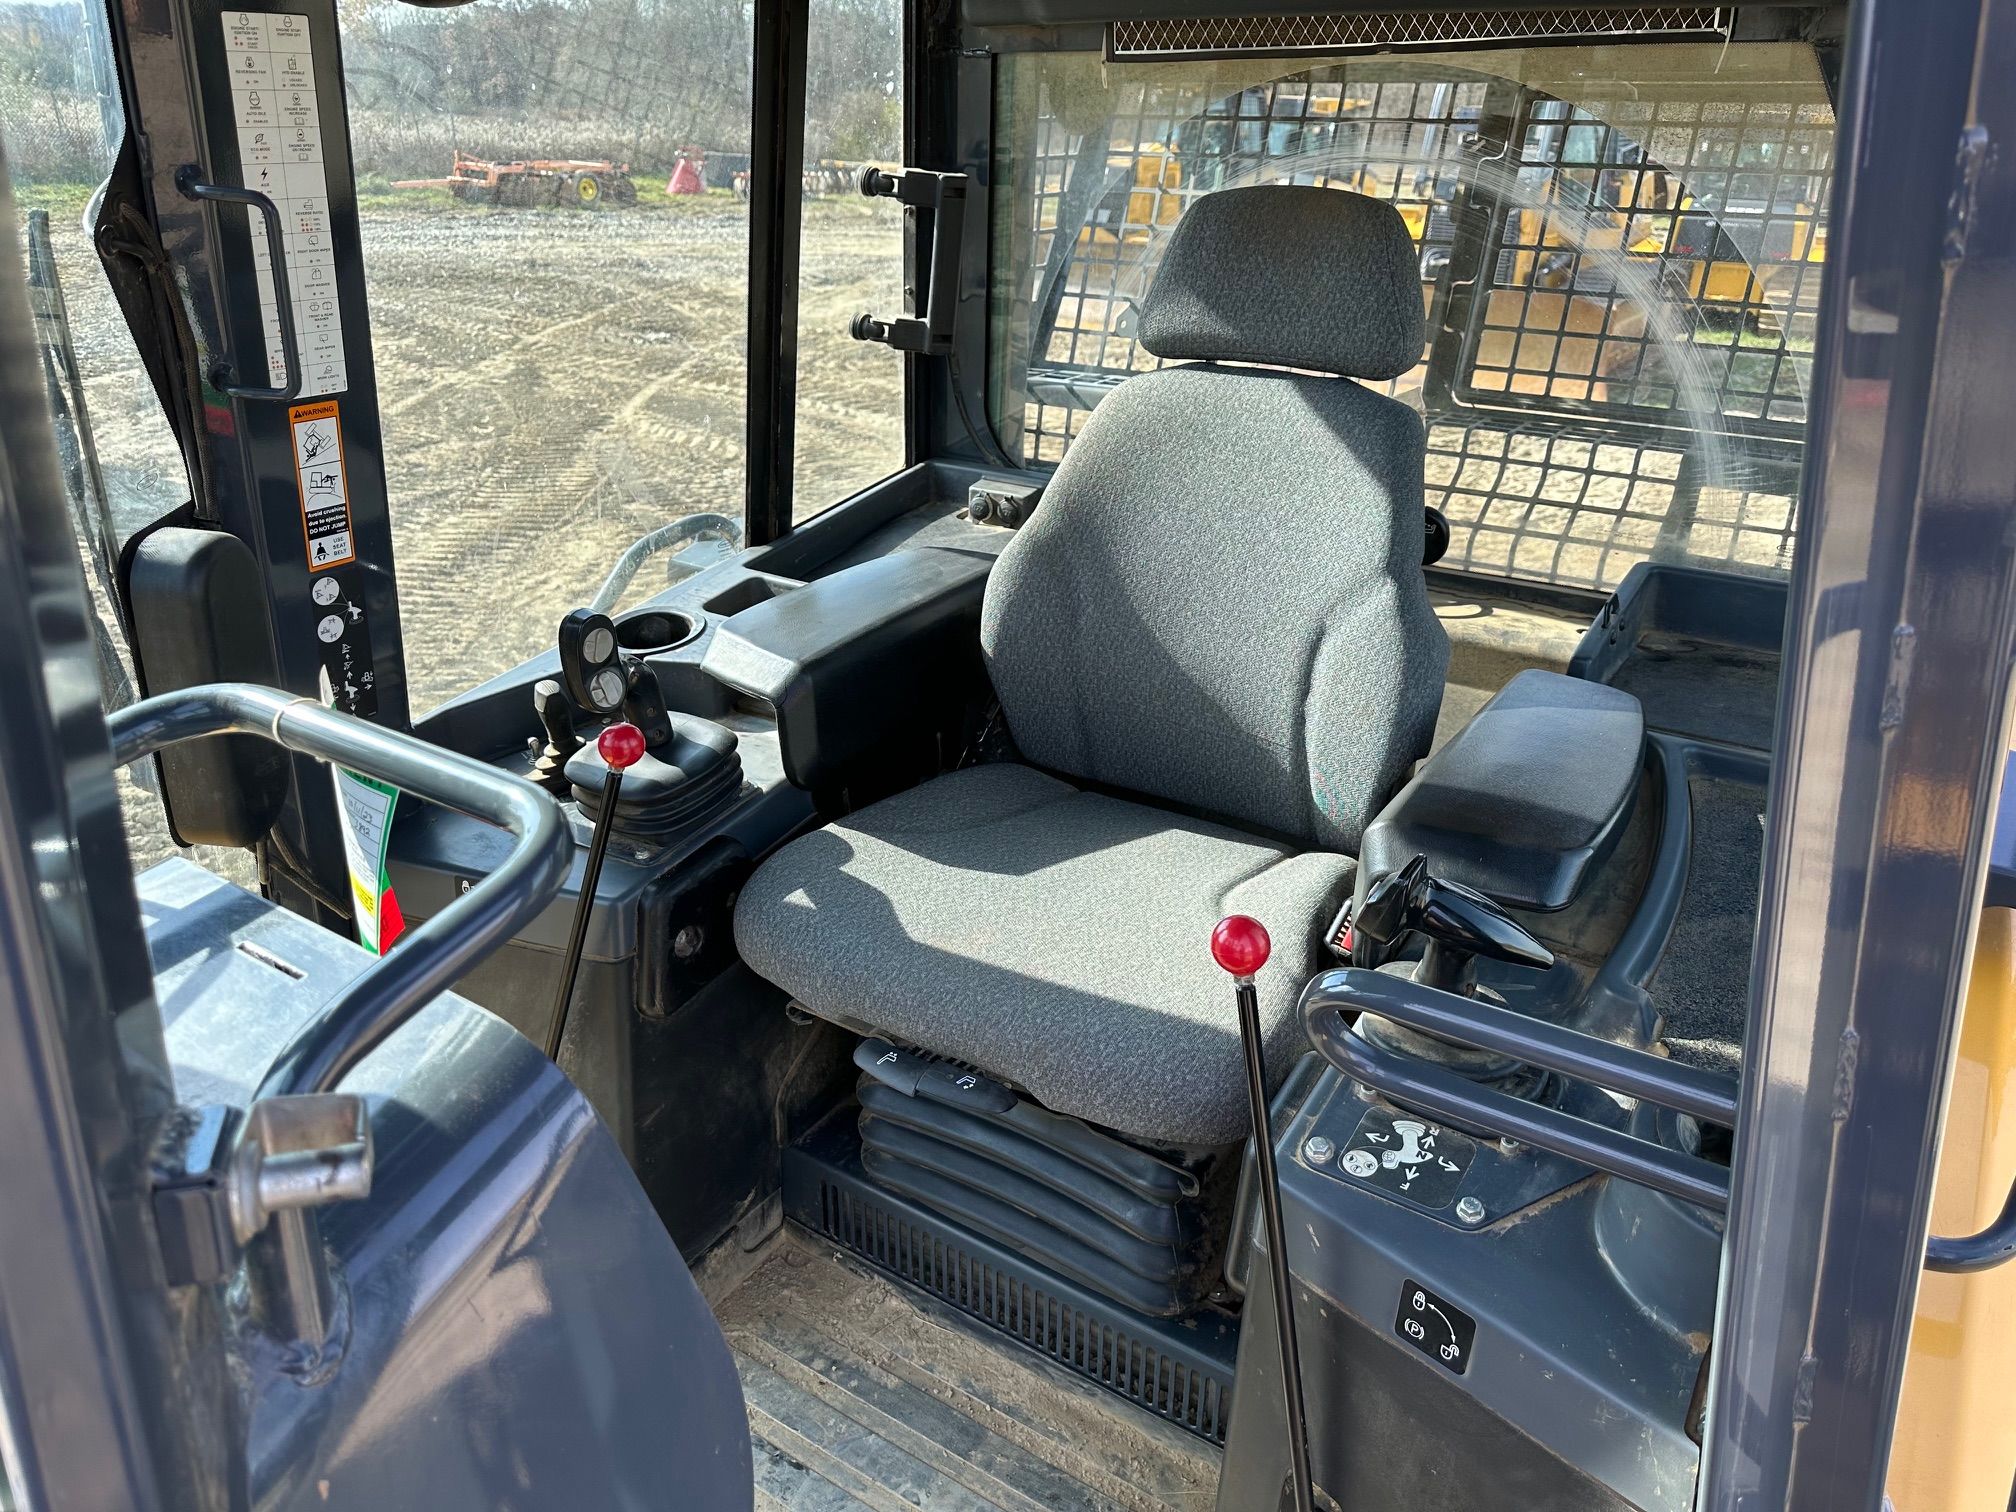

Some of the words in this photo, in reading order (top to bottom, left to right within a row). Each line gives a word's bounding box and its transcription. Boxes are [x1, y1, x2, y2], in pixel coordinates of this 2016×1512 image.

[301, 406, 334, 416] WARNING
[307, 511, 322, 519] Avoid
[323, 505, 346, 515] crushing
[331, 521, 346, 530] JUMP
[333, 548, 347, 556] BELT
[1399, 1181, 1411, 1191] F
[1410, 1322, 1419, 1333] P
